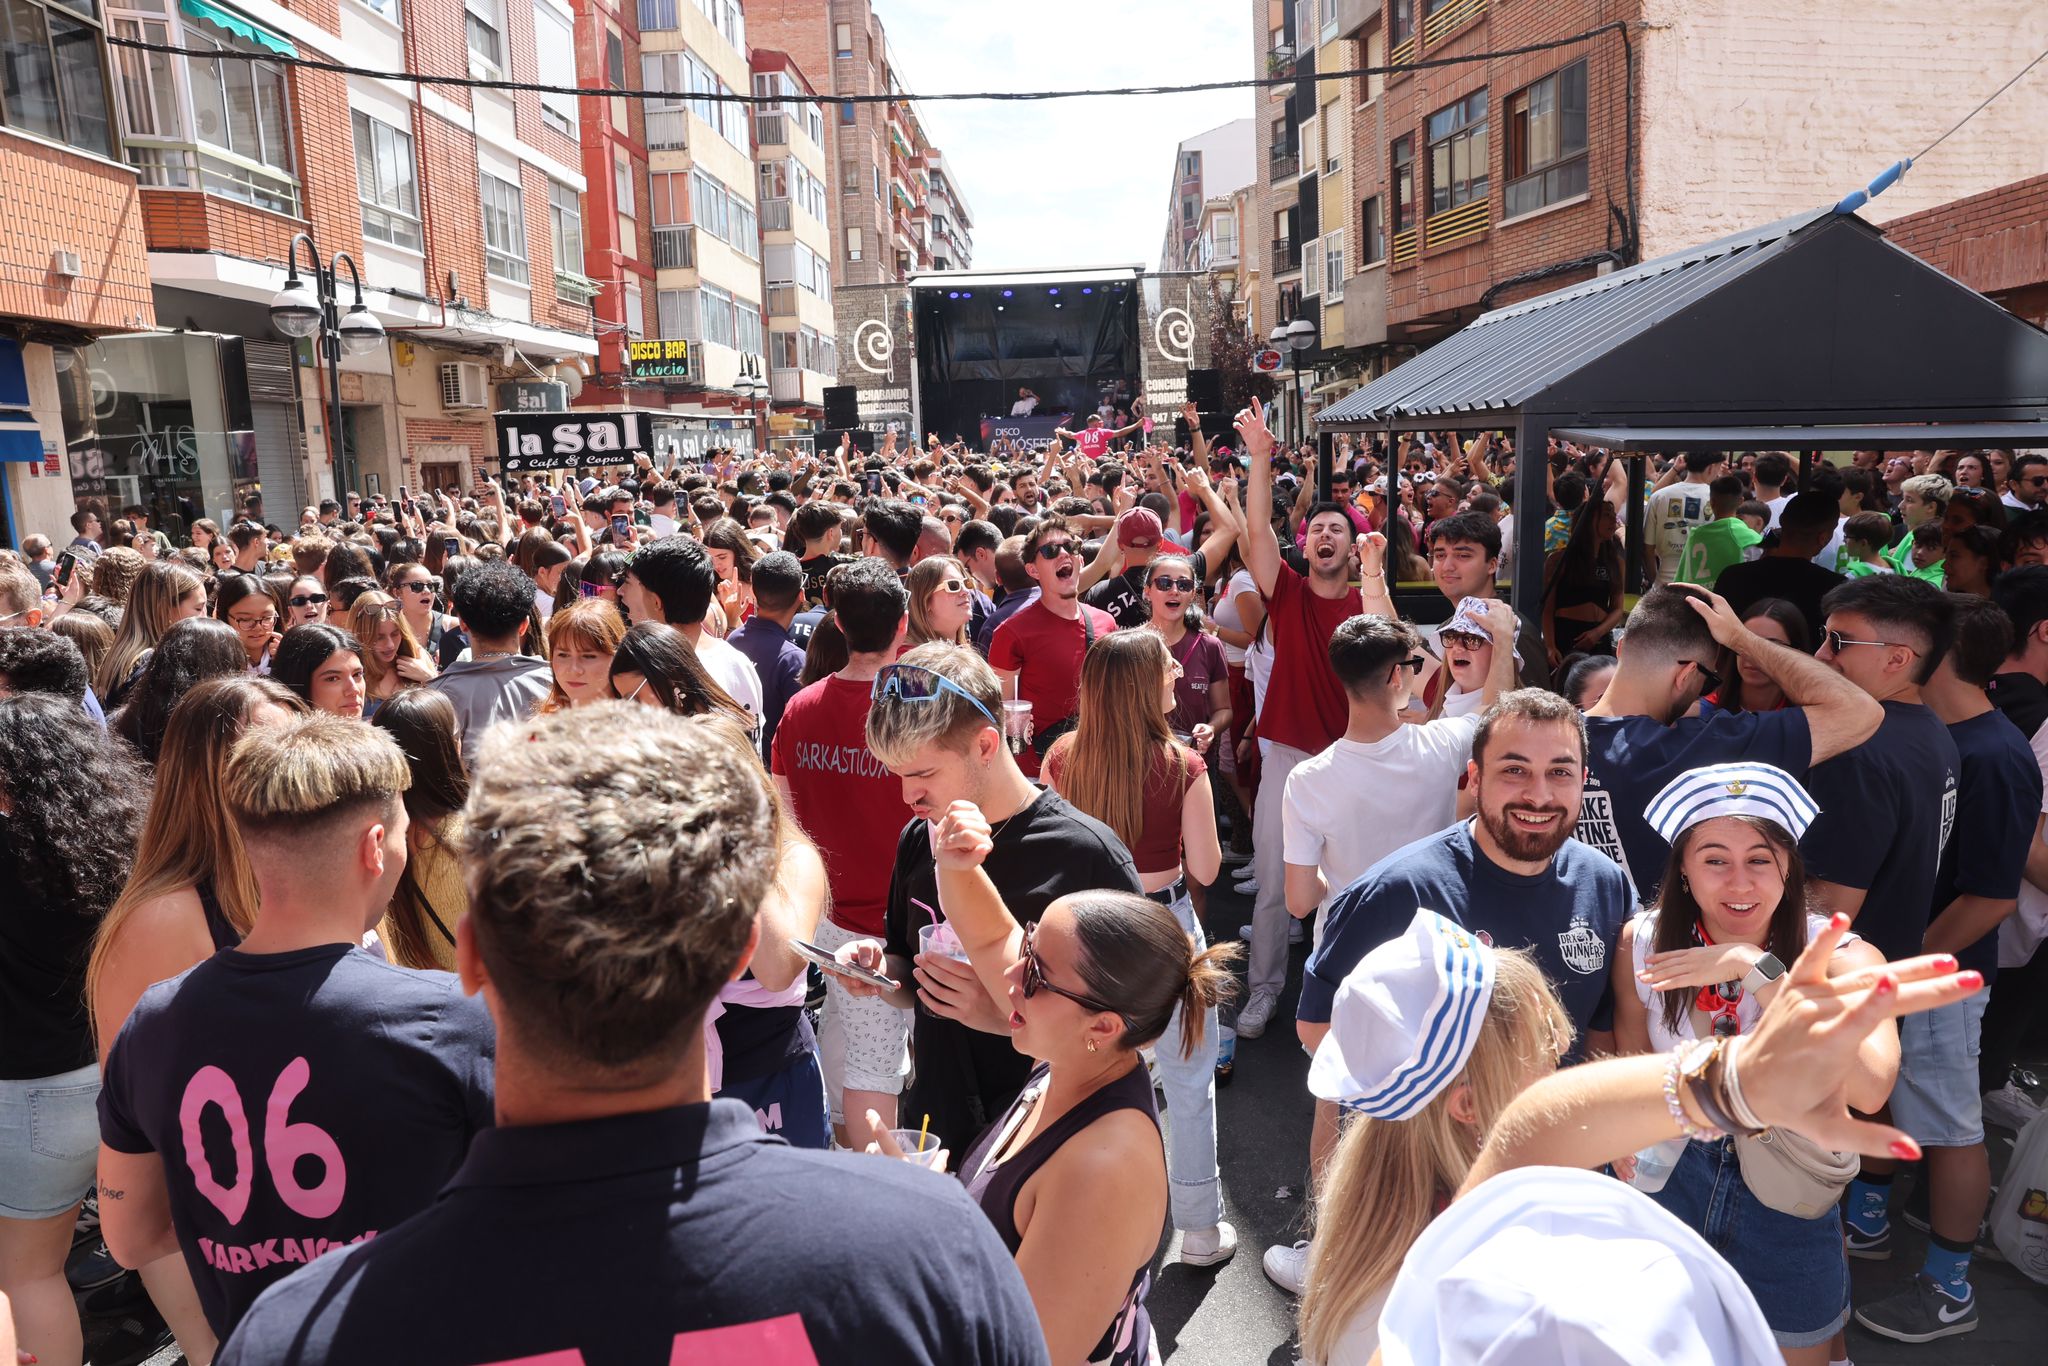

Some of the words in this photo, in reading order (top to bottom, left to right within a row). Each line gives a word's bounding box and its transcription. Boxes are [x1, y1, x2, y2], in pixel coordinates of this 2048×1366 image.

[631, 342, 661, 360] DISCO
[665, 341, 687, 359] BAR
[518, 392, 546, 408] sal
[506, 427, 543, 457] la
[552, 414, 642, 453] sal
[995, 427, 1020, 437] DISCO
[529, 458, 559, 469] Café
[565, 455, 580, 467] &
[586, 455, 625, 465] Copas
[794, 623, 816, 637] TE
[1579, 797, 1610, 820] IKE
[1562, 941, 1605, 959] WINNERS
[1587, 958, 1603, 969] CLUB
[179, 1056, 346, 1225] 06
